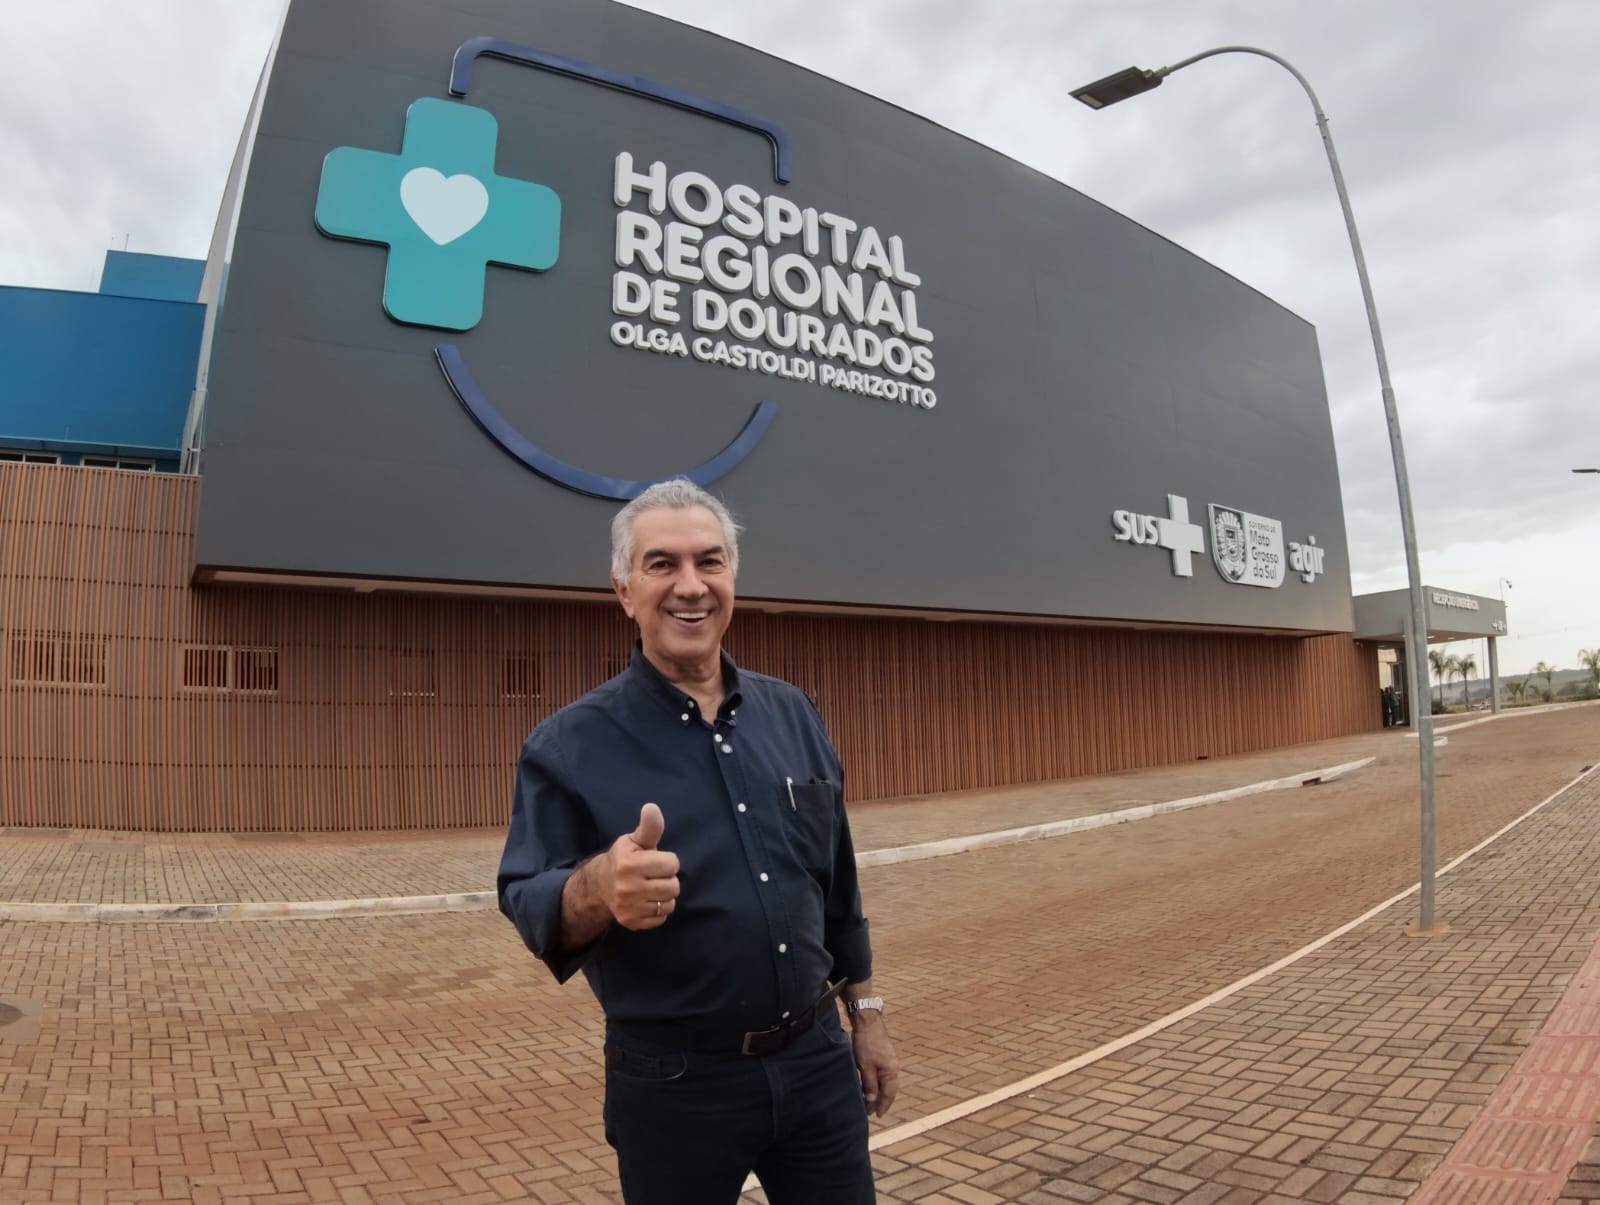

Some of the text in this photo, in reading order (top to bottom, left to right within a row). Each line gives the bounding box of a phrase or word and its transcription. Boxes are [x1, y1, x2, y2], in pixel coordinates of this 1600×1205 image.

[613, 151, 921, 288] HOSPITAL
[614, 210, 934, 343] REGIONAL
[612, 270, 936, 383] DE DOURADOS
[610, 321, 937, 410] OLGA CASTOLDI PARIZOTTO
[1113, 509, 1158, 545] SUS
[1249, 529, 1271, 547] Mato
[1251, 546, 1279, 564] Grosso
[1265, 565, 1277, 580] Sul
[1288, 535, 1325, 584] agir
